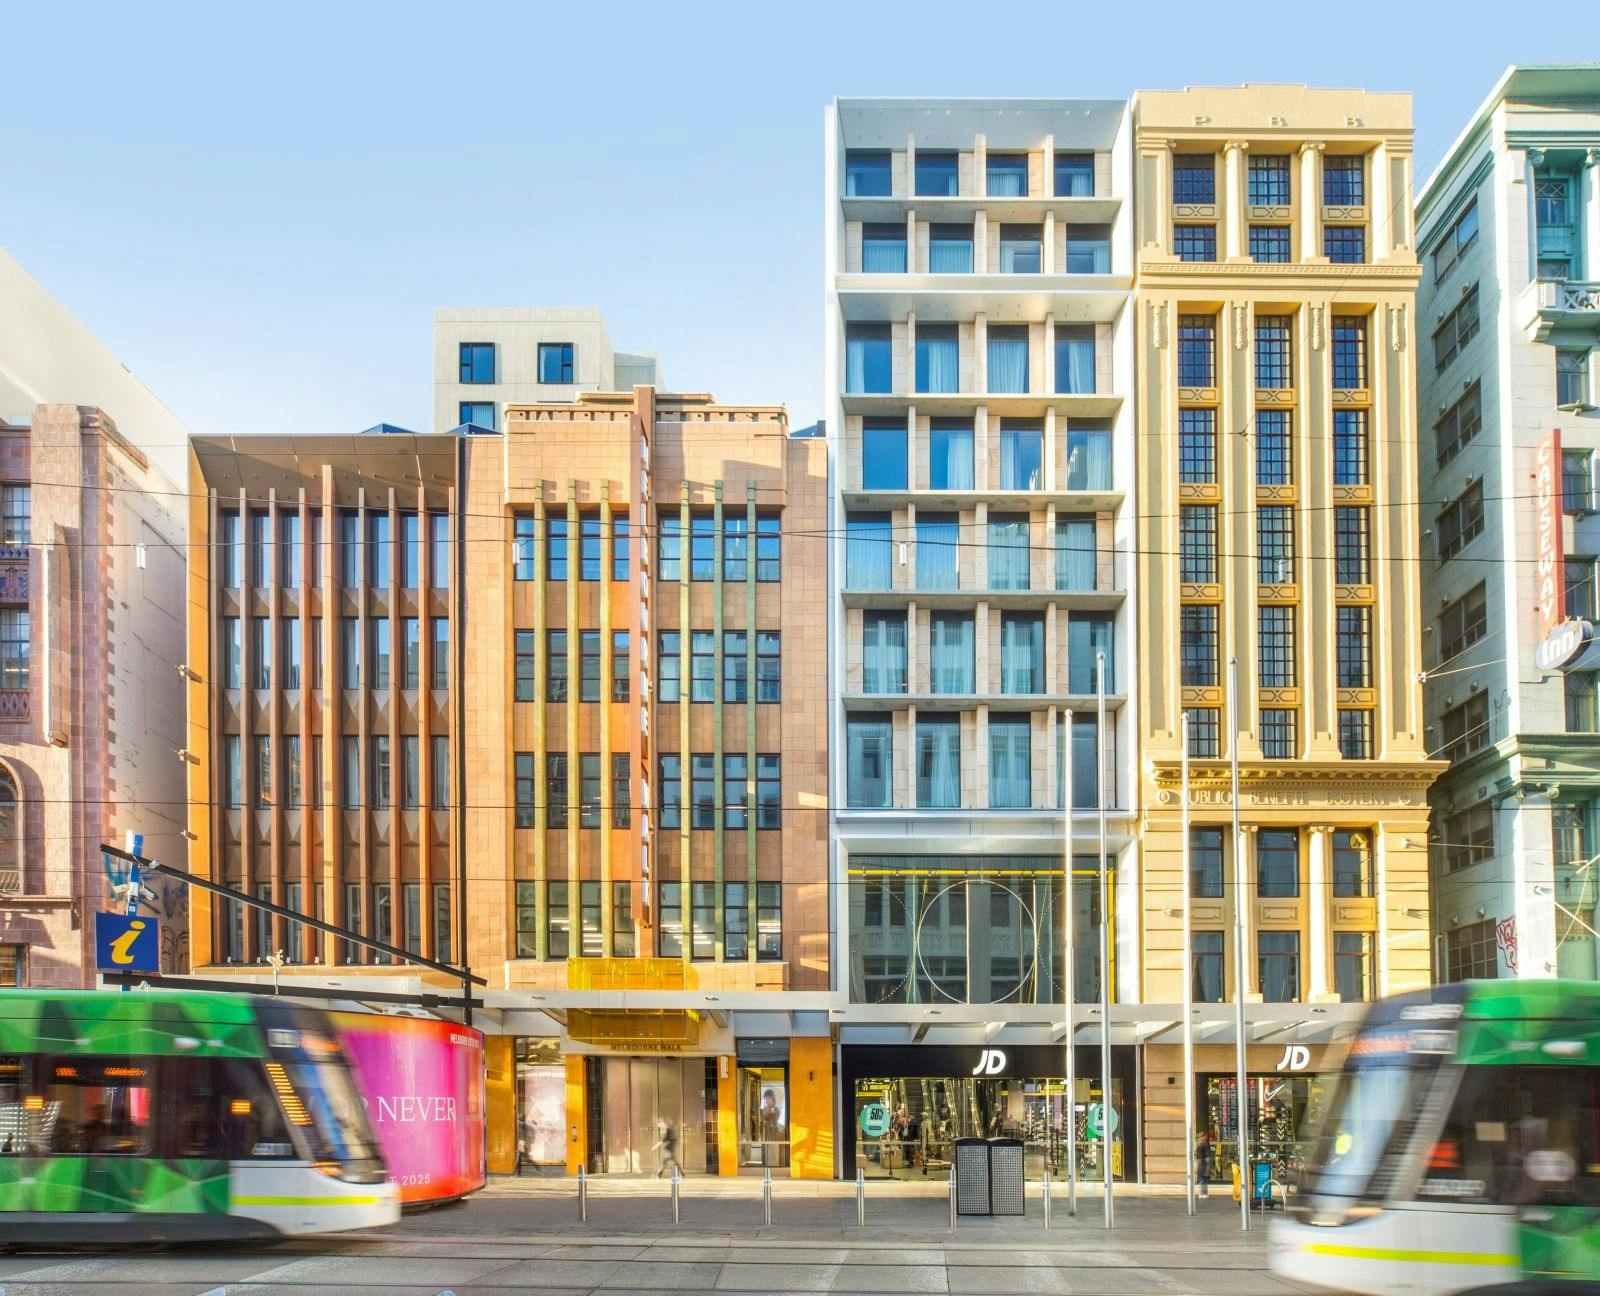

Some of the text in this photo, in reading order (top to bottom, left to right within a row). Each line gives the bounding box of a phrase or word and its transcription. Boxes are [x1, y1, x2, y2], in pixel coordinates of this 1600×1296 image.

[1538, 440, 1553, 620] CAUSEWAY
[1183, 790, 1233, 804] UBLIC
[611, 1043, 682, 1052] MELBOURNE WALK
[1276, 1045, 1310, 1071] JD
[973, 1049, 1007, 1075] JD
[376, 1096, 457, 1122] NEVER
[402, 1173, 431, 1186] 2025
